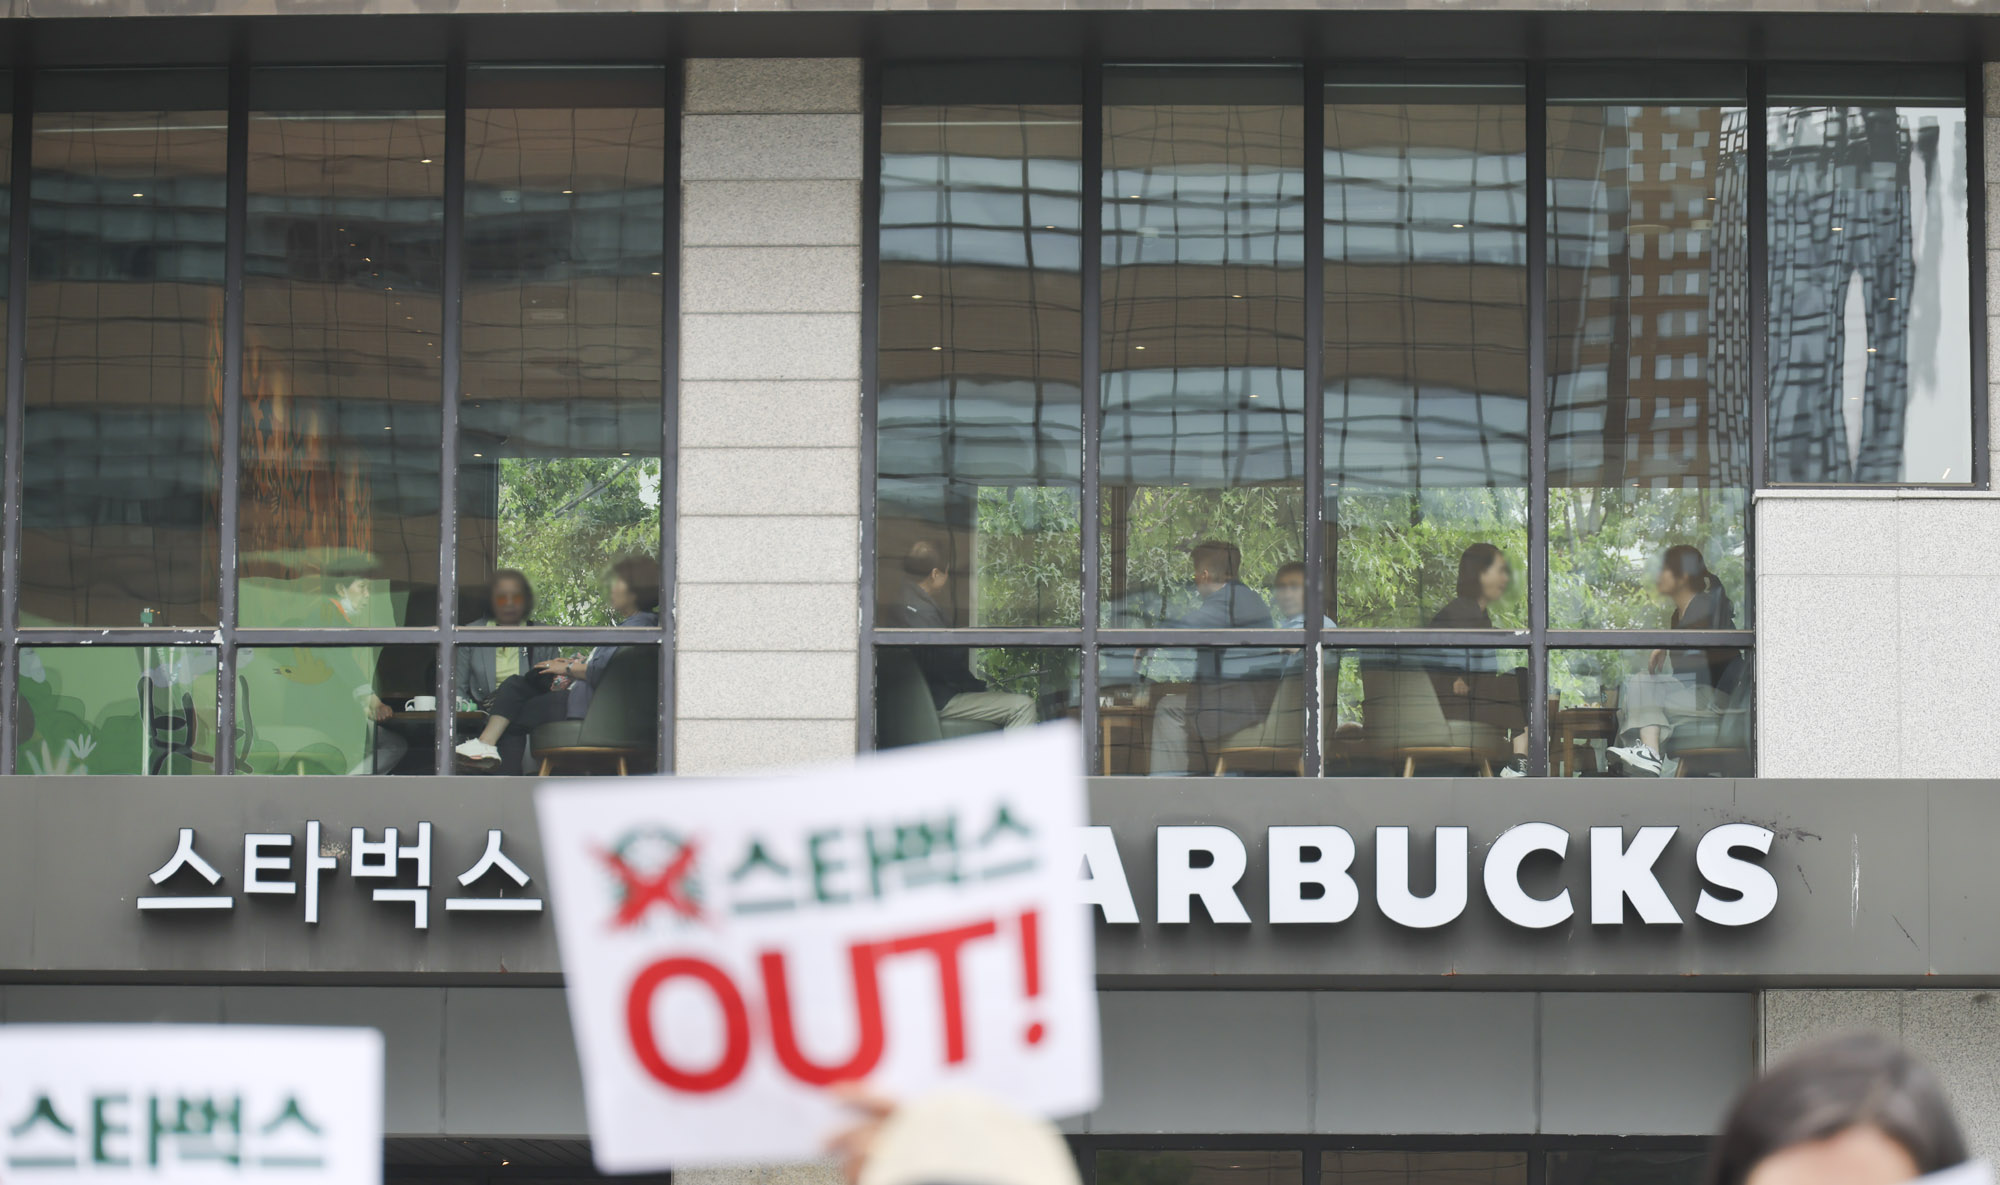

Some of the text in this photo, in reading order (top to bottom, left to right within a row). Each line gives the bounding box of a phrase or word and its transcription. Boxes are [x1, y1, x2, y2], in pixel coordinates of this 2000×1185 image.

[136, 820, 543, 929] 스타벅스
[731, 804, 1037, 914] 스타벅스
[1076, 822, 1780, 929] ARBUCKS
[624, 908, 1045, 1095] OUT!
[6, 1092, 323, 1171] 스타벅스
